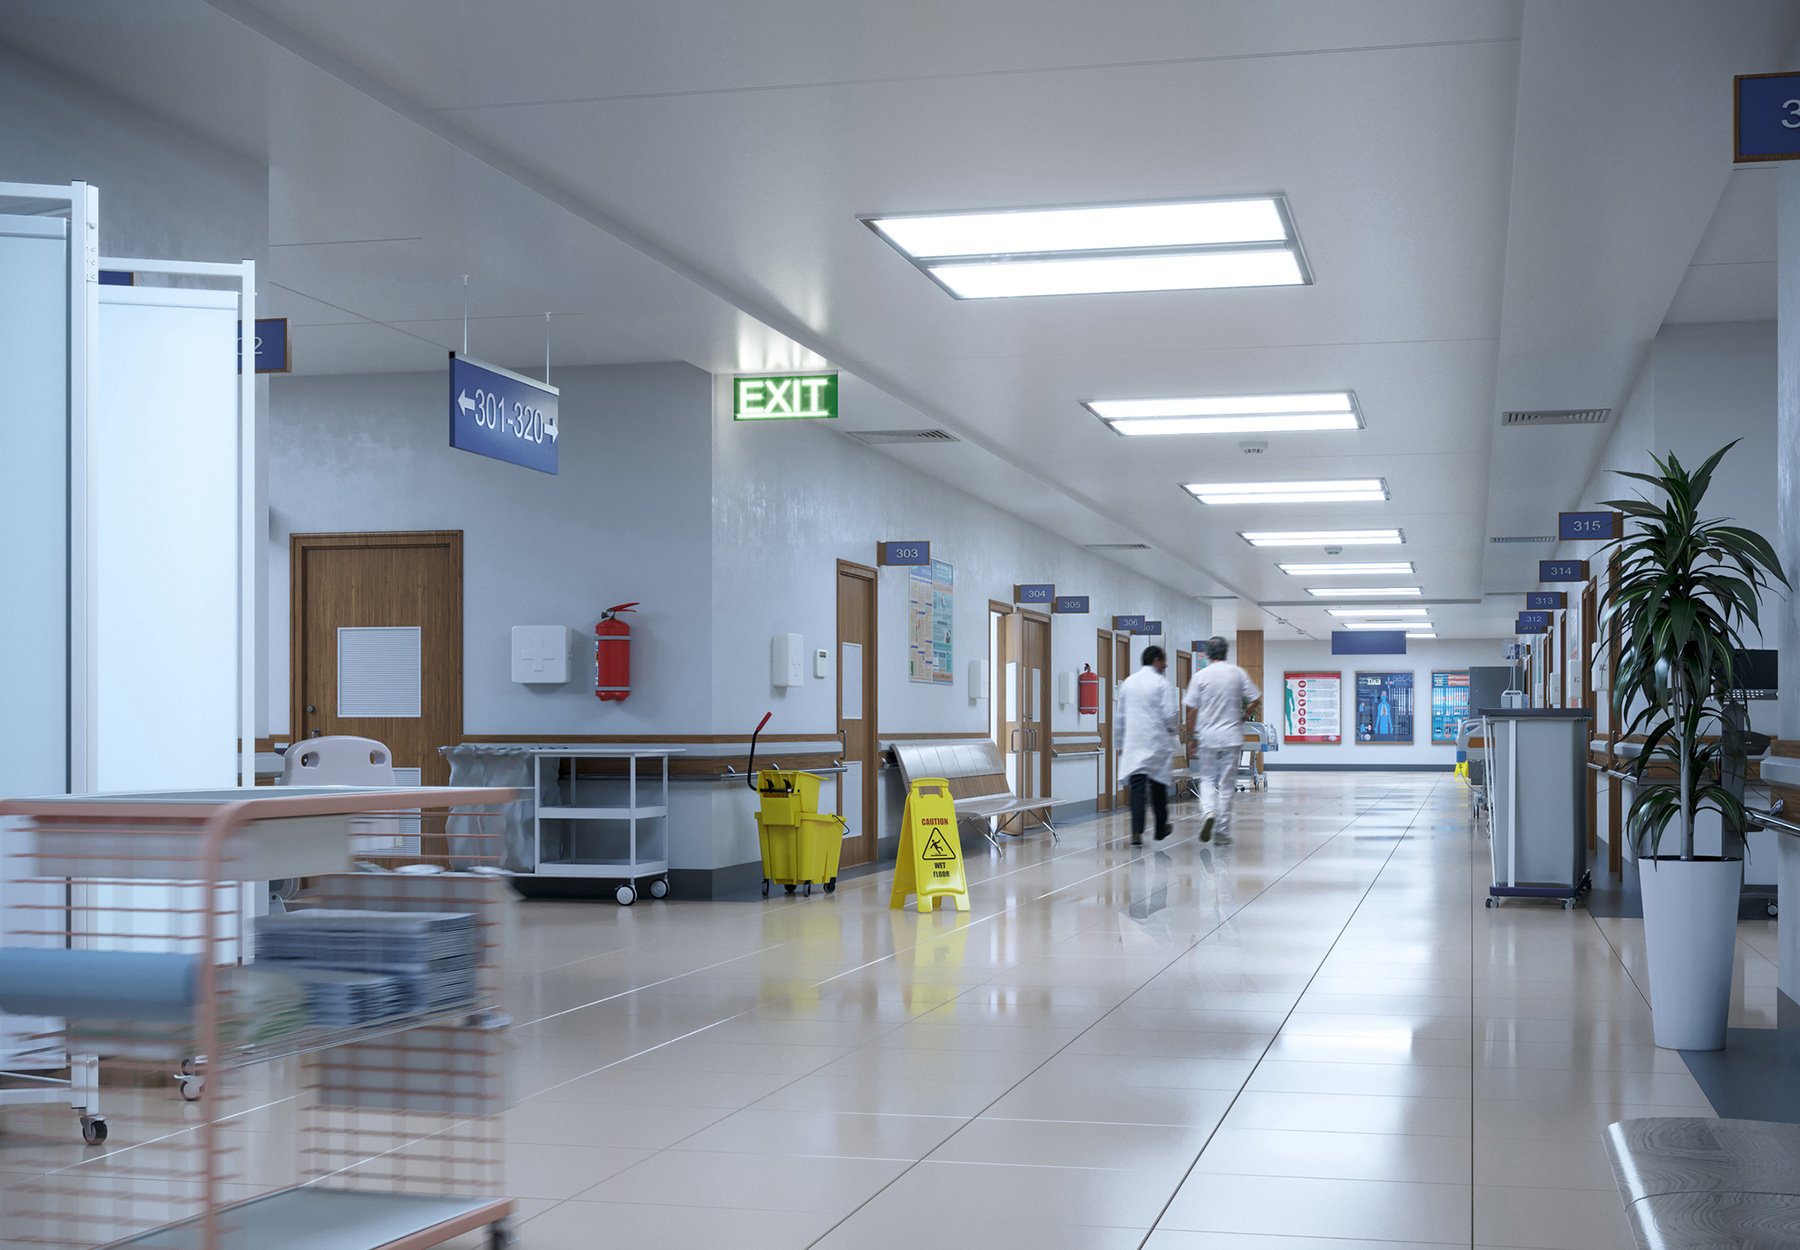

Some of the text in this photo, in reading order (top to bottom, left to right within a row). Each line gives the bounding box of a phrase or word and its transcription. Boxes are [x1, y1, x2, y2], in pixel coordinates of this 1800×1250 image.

[740, 378, 828, 414] EXIT
[474, 388, 543, 444] 301-320
[1573, 520, 1601, 532] 315
[896, 548, 919, 558] 303
[1550, 566, 1572, 576] 314
[1028, 590, 1046, 598] 304
[1064, 601, 1081, 609] 305
[1535, 597, 1554, 605] 313
[1123, 619, 1138, 627] 306
[921, 818, 949, 826] CAUTION
